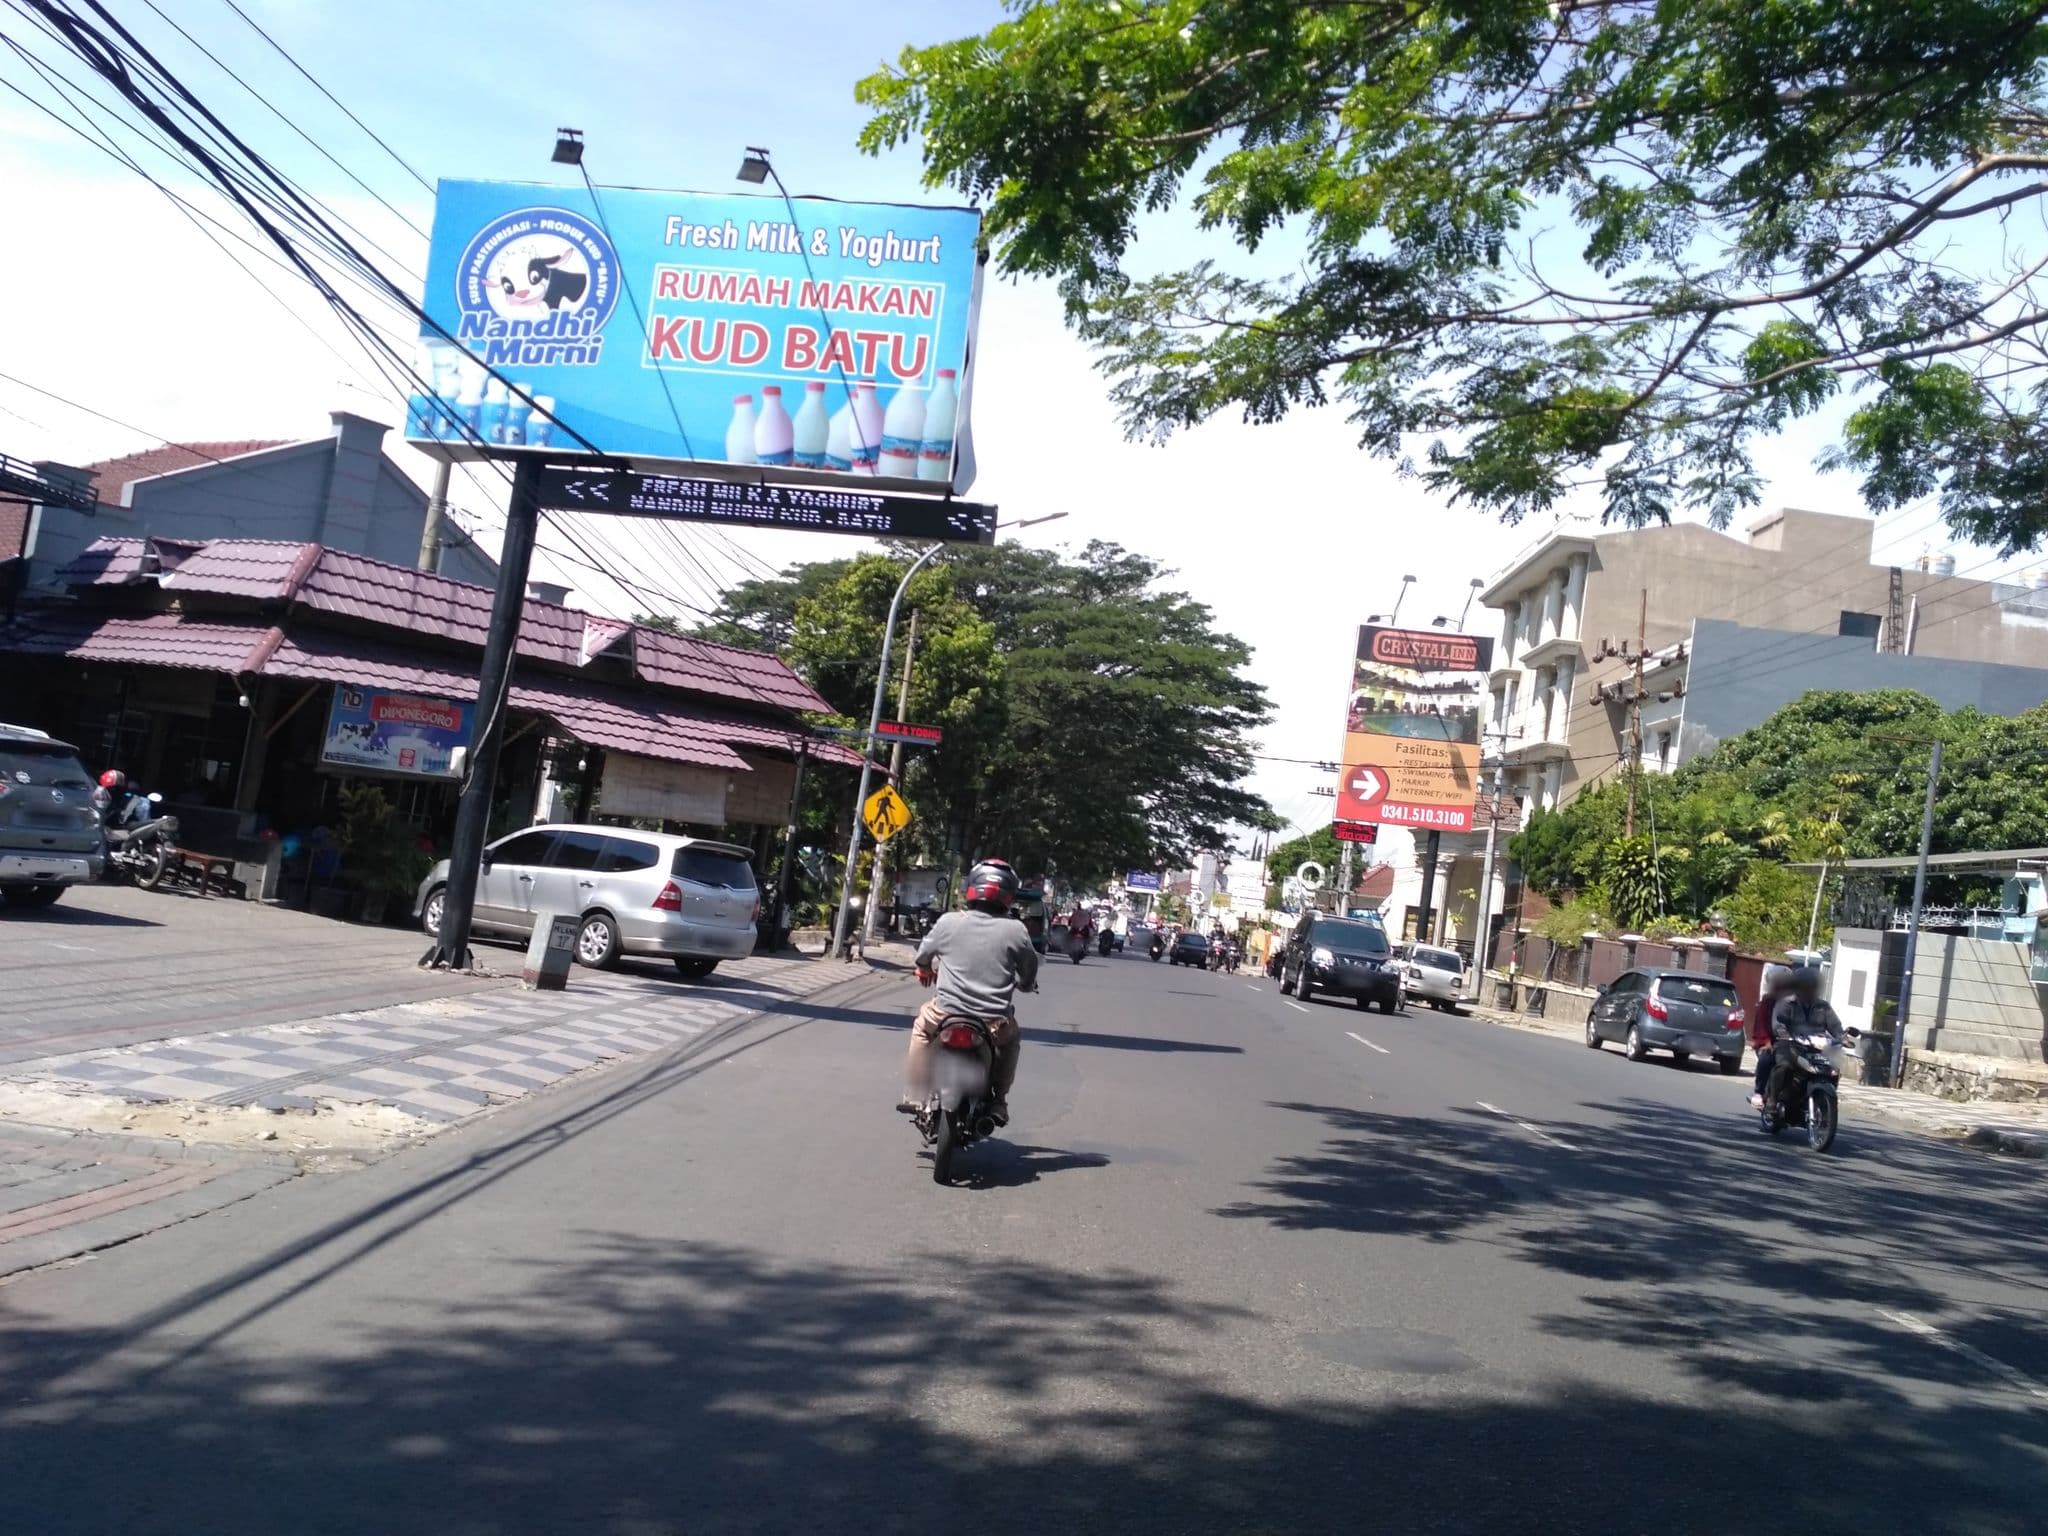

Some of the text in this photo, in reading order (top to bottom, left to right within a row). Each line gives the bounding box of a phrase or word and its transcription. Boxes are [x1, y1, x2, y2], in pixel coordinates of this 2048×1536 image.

[540, 219, 587, 241] PRODUK
[664, 215, 943, 268] Fresh Milk & Yoghurt
[470, 220, 531, 274] PASTEURISASI
[582, 237, 602, 261] KUD
[469, 276, 481, 305] SUSU
[657, 270, 935, 317] RUMAH MAKAN
[458, 309, 597, 339] Nandhi
[486, 337, 604, 366] Murni
[651, 316, 929, 380] KUD BATU
[1381, 638, 1475, 660] CRYSTAL INN
[379, 707, 454, 728] DIPONEGORO
[1395, 742, 1449, 758] Fasilitas:
[1400, 778, 1431, 787] PARKIR
[1402, 768, 1447, 779] SWIMMING
[1399, 787, 1463, 800] INTERNET/WIFI
[1381, 804, 1465, 826] 0341.510.3100
